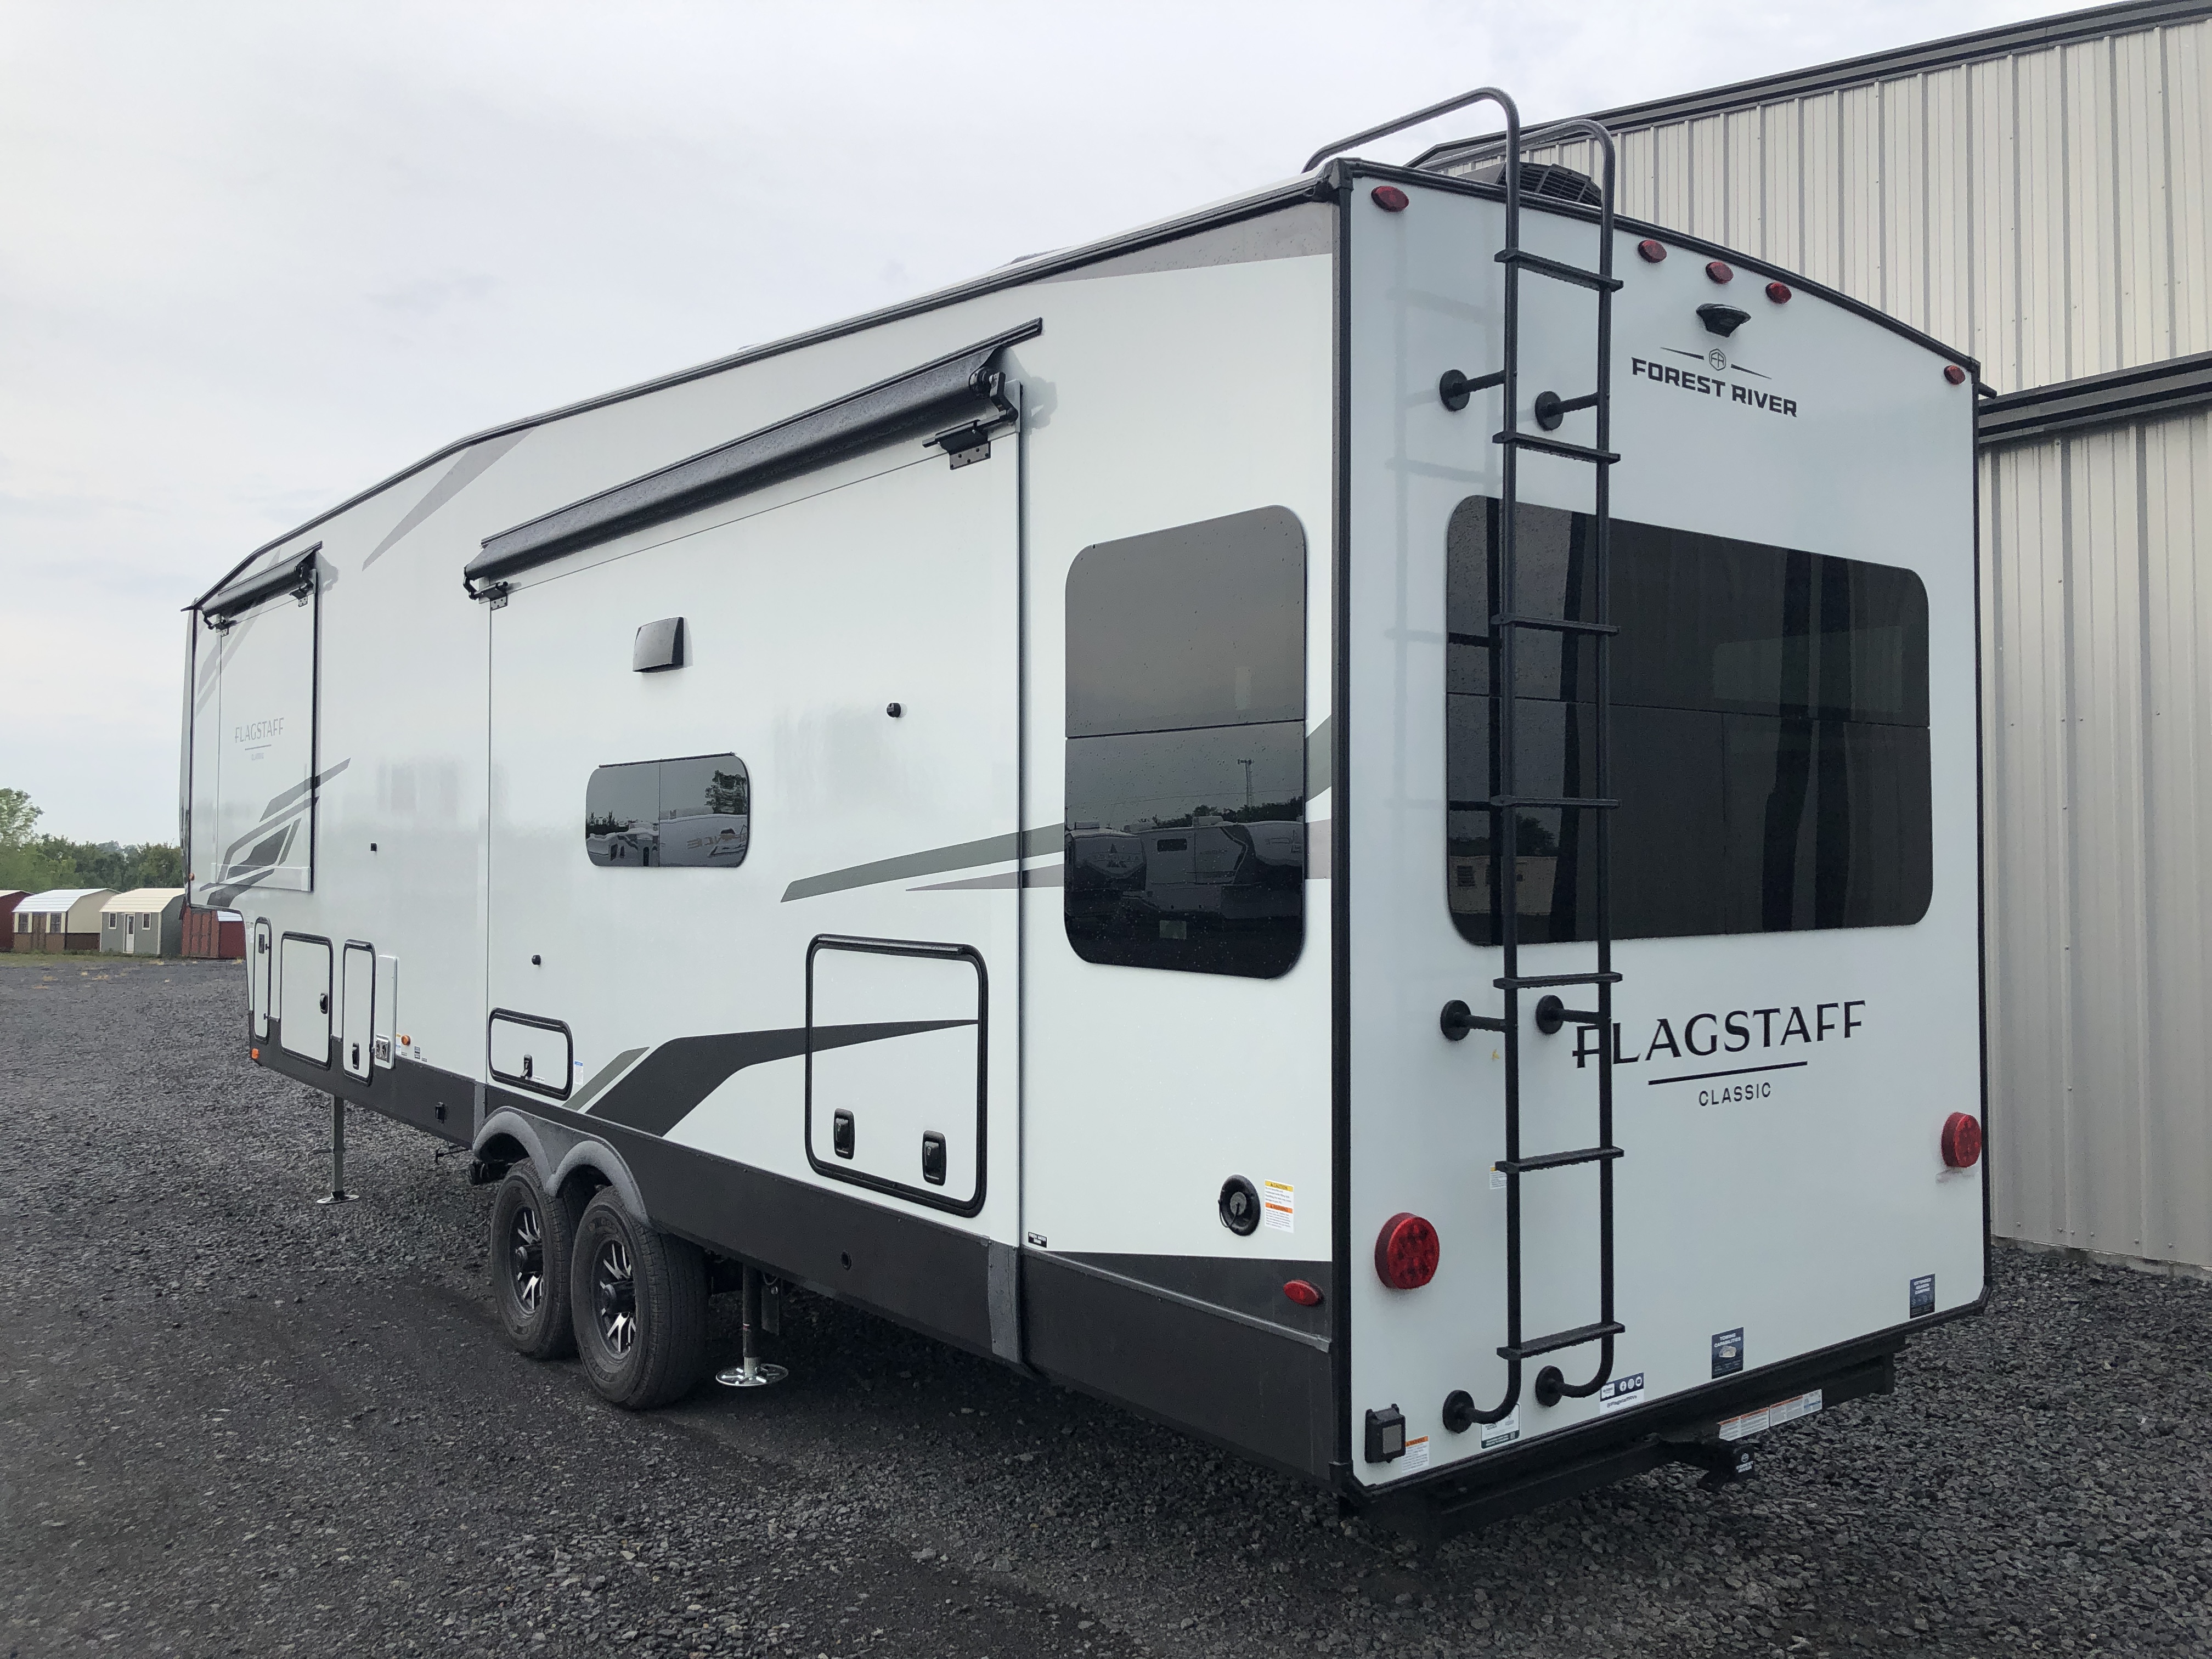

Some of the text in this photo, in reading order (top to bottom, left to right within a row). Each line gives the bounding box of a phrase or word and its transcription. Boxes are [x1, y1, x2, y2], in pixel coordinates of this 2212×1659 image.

[1632, 357, 1797, 417] FOREST RIVER
[235, 717, 284, 743] FLAGSTAFF
[1572, 1000, 1866, 1069] FLAGSTAFF
[1699, 1082, 1771, 1107] CLASSIC
